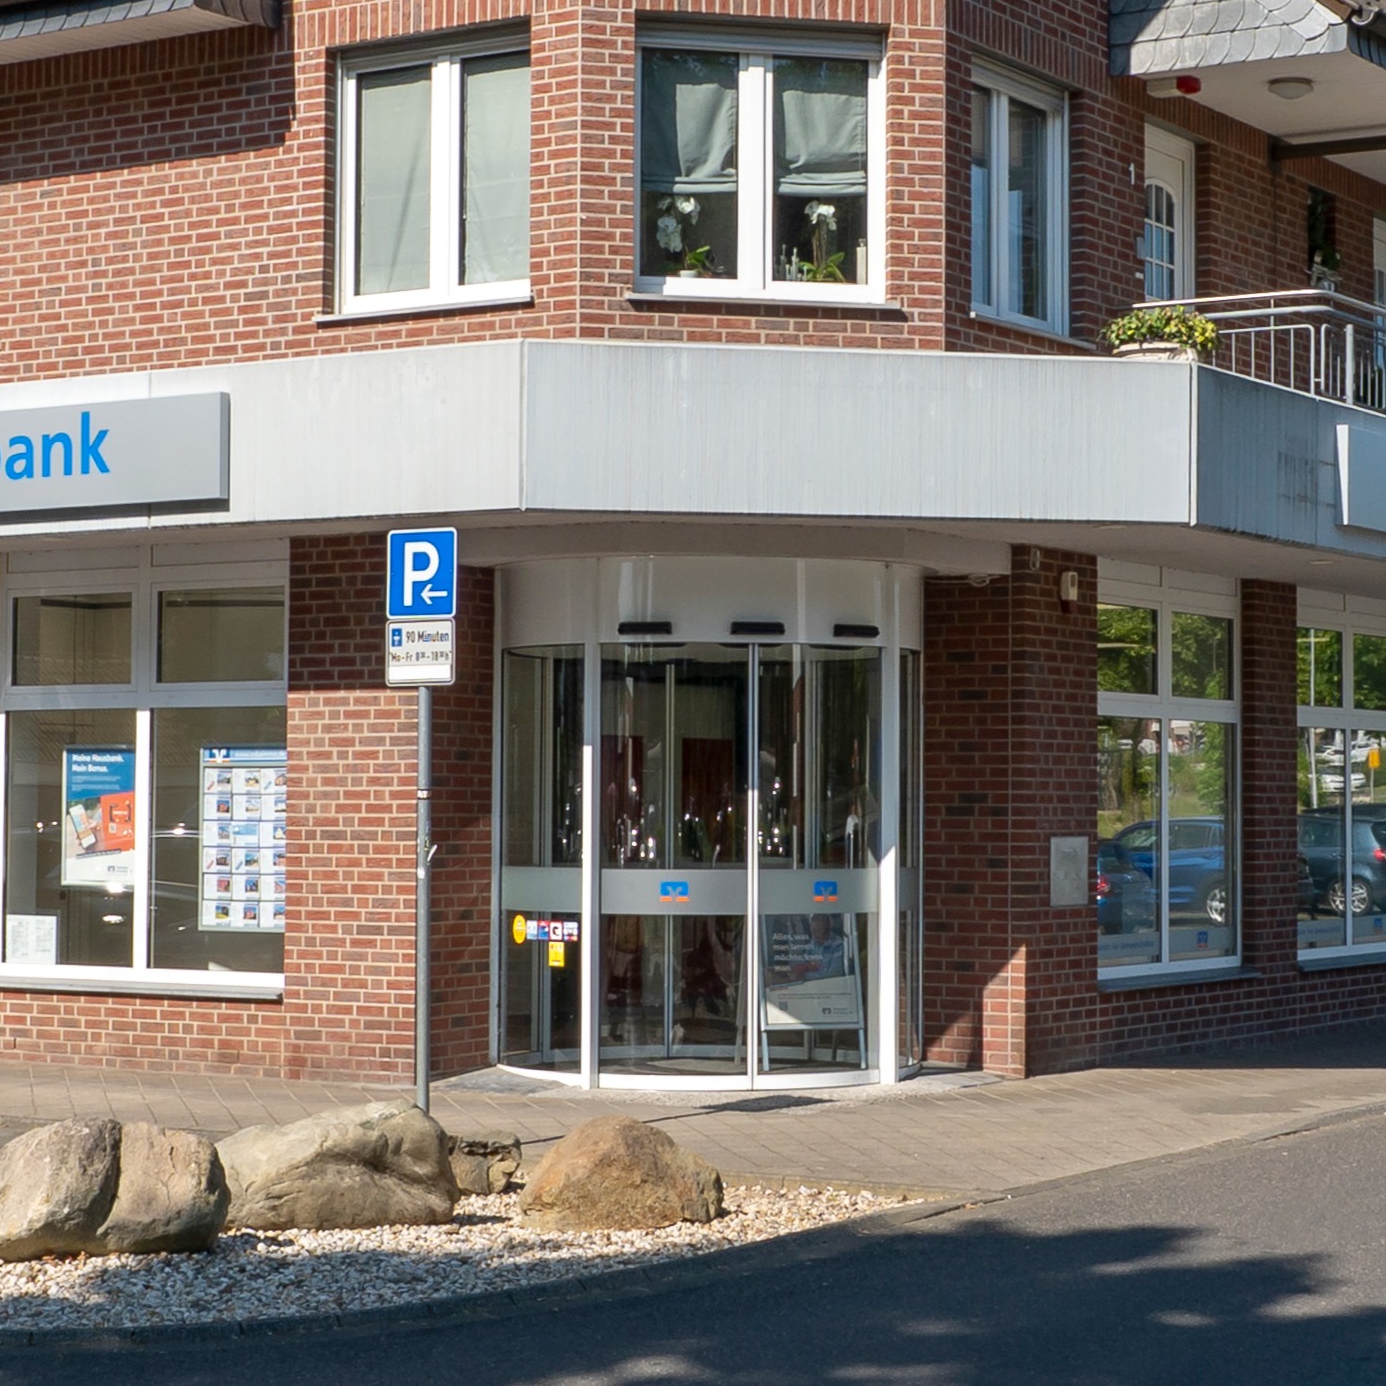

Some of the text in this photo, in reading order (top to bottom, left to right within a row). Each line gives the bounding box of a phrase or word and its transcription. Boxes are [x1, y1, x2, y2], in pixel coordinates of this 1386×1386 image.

[403, 541, 440, 607] P
[406, 630, 450, 643] 90 Minuten
